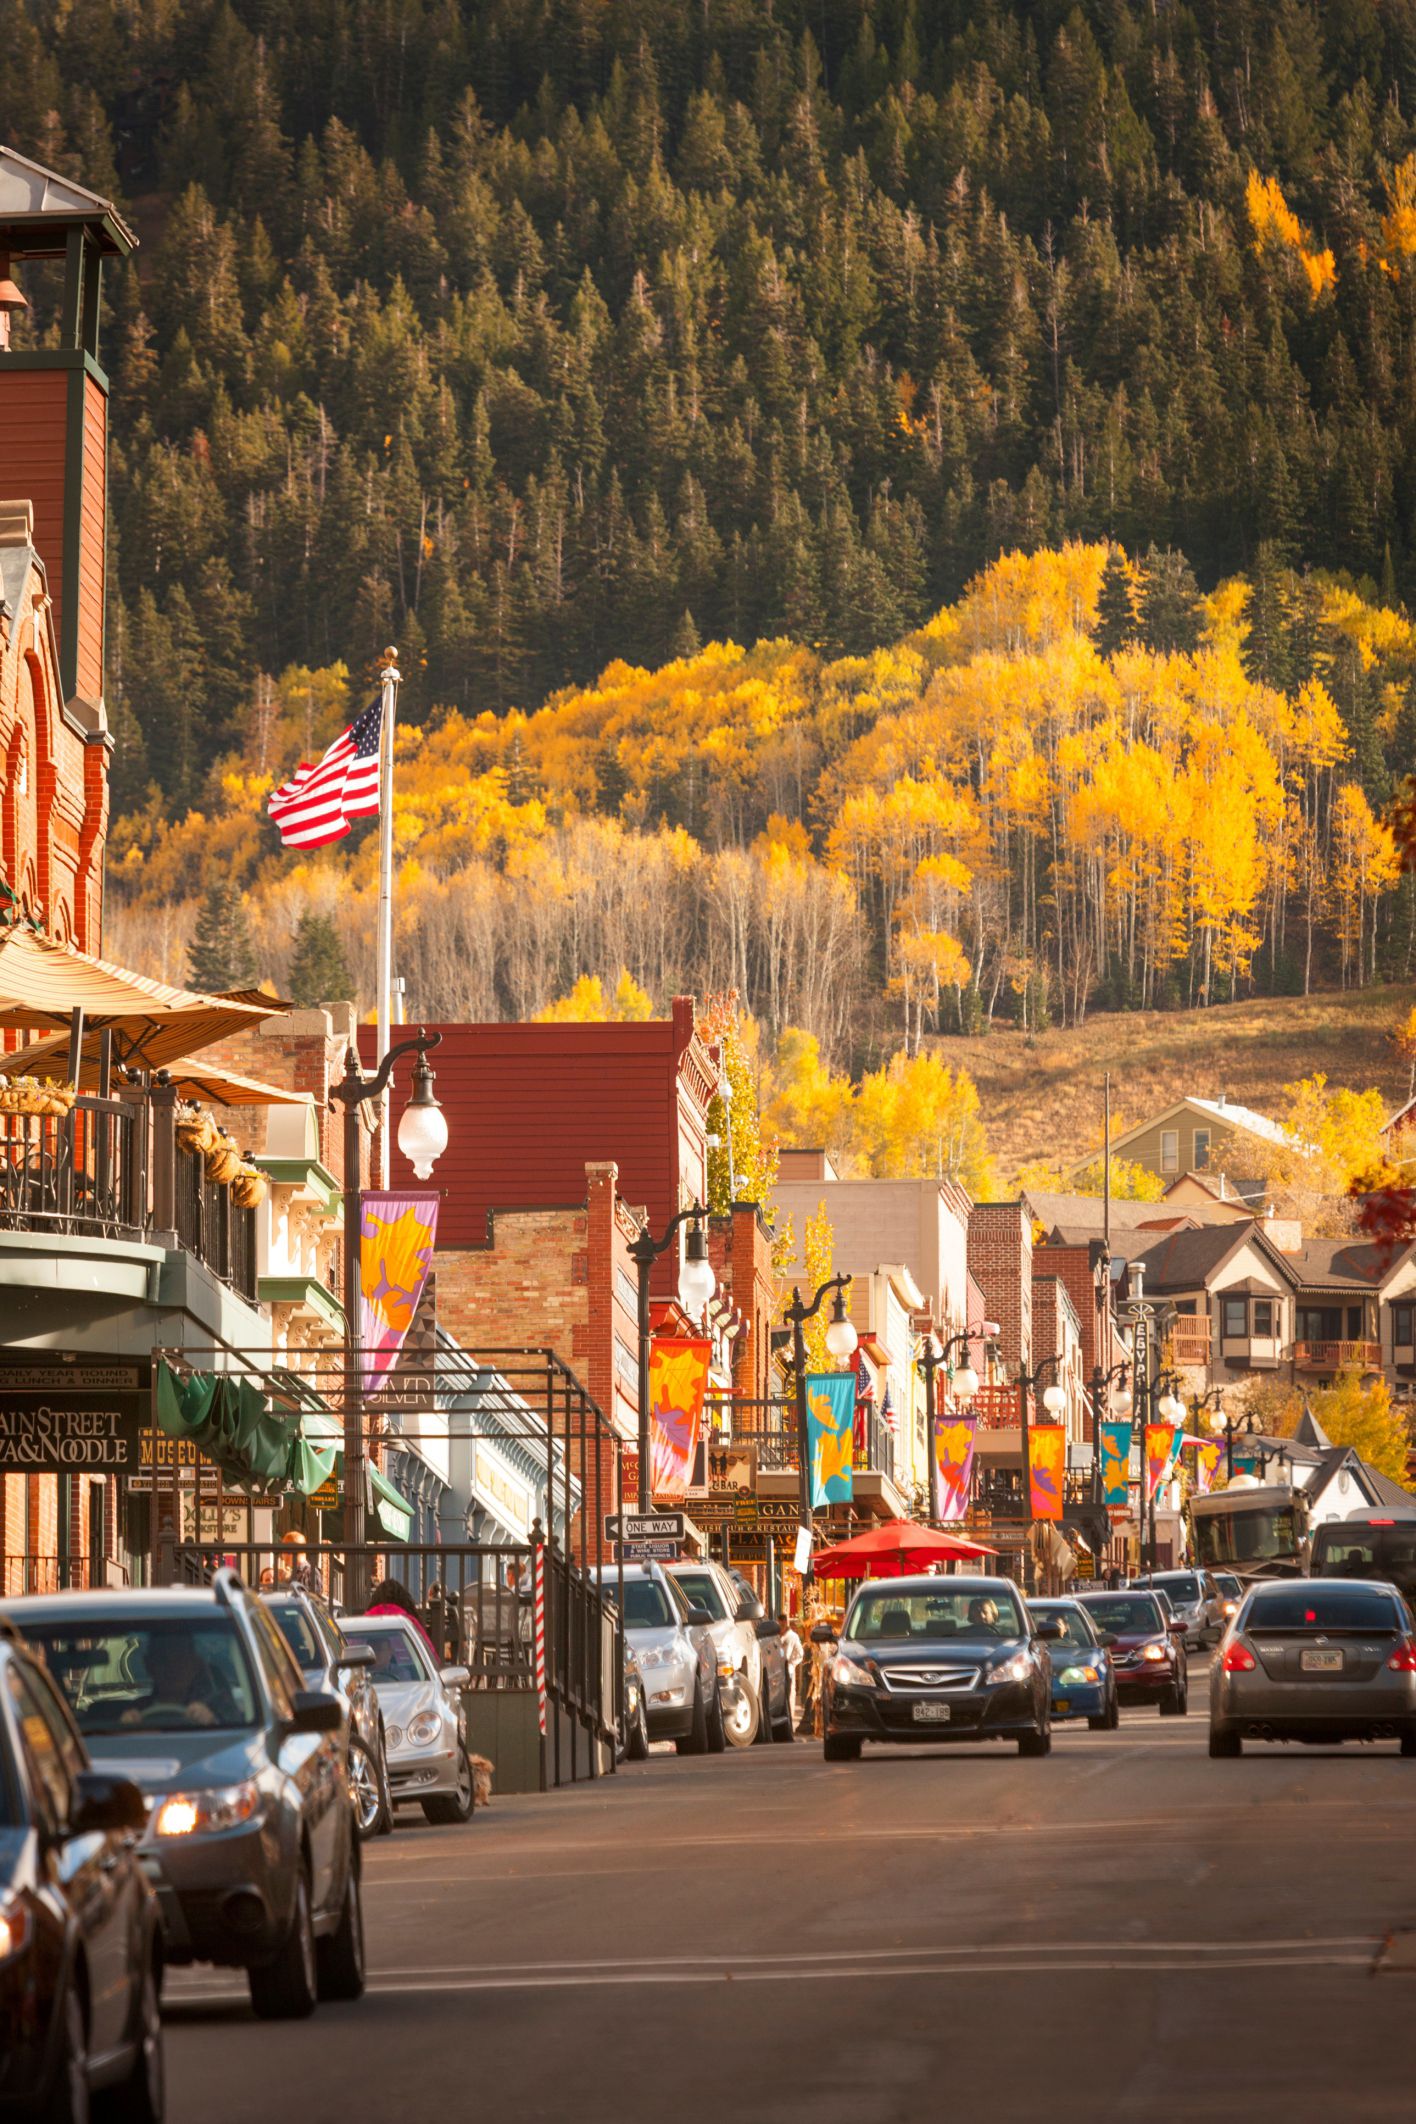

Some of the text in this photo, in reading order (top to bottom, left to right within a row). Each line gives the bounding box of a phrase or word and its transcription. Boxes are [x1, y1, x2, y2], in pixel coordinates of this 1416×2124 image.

[721, 1481, 738, 1490] BAR
[221, 1496, 276, 1505] DOWNTAIRS
[626, 1521, 674, 1533] ONE WAY
